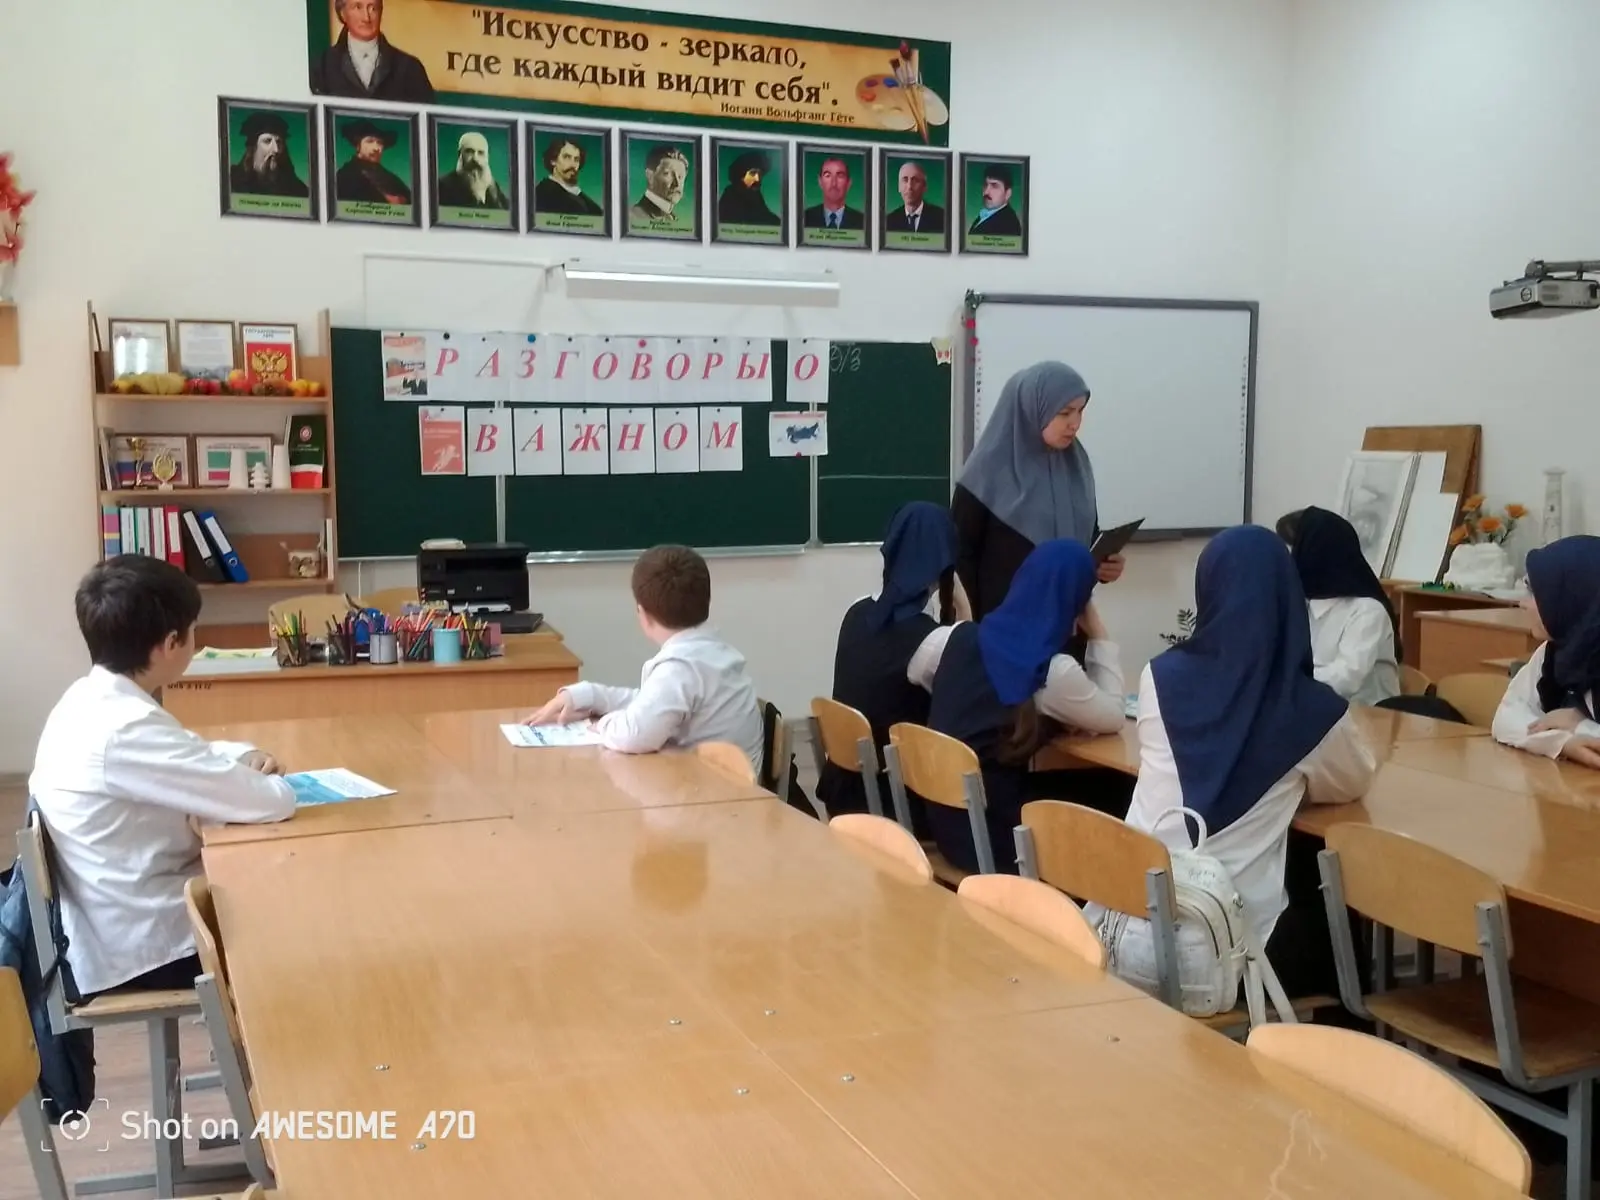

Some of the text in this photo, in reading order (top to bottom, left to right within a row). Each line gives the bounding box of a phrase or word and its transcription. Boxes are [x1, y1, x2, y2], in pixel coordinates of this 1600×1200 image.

[472, 9, 649, 52] "Искусство
[679, 36, 806, 70] зеркало,
[446, 51, 838, 106] где каждый видит себя".
[720, 102, 763, 116] Иоганн
[766, 105, 826, 122] Вольфганг
[433, 347, 819, 382] РАЗГОВОРЫ О
[474, 421, 739, 453] ВАЖНОМ
